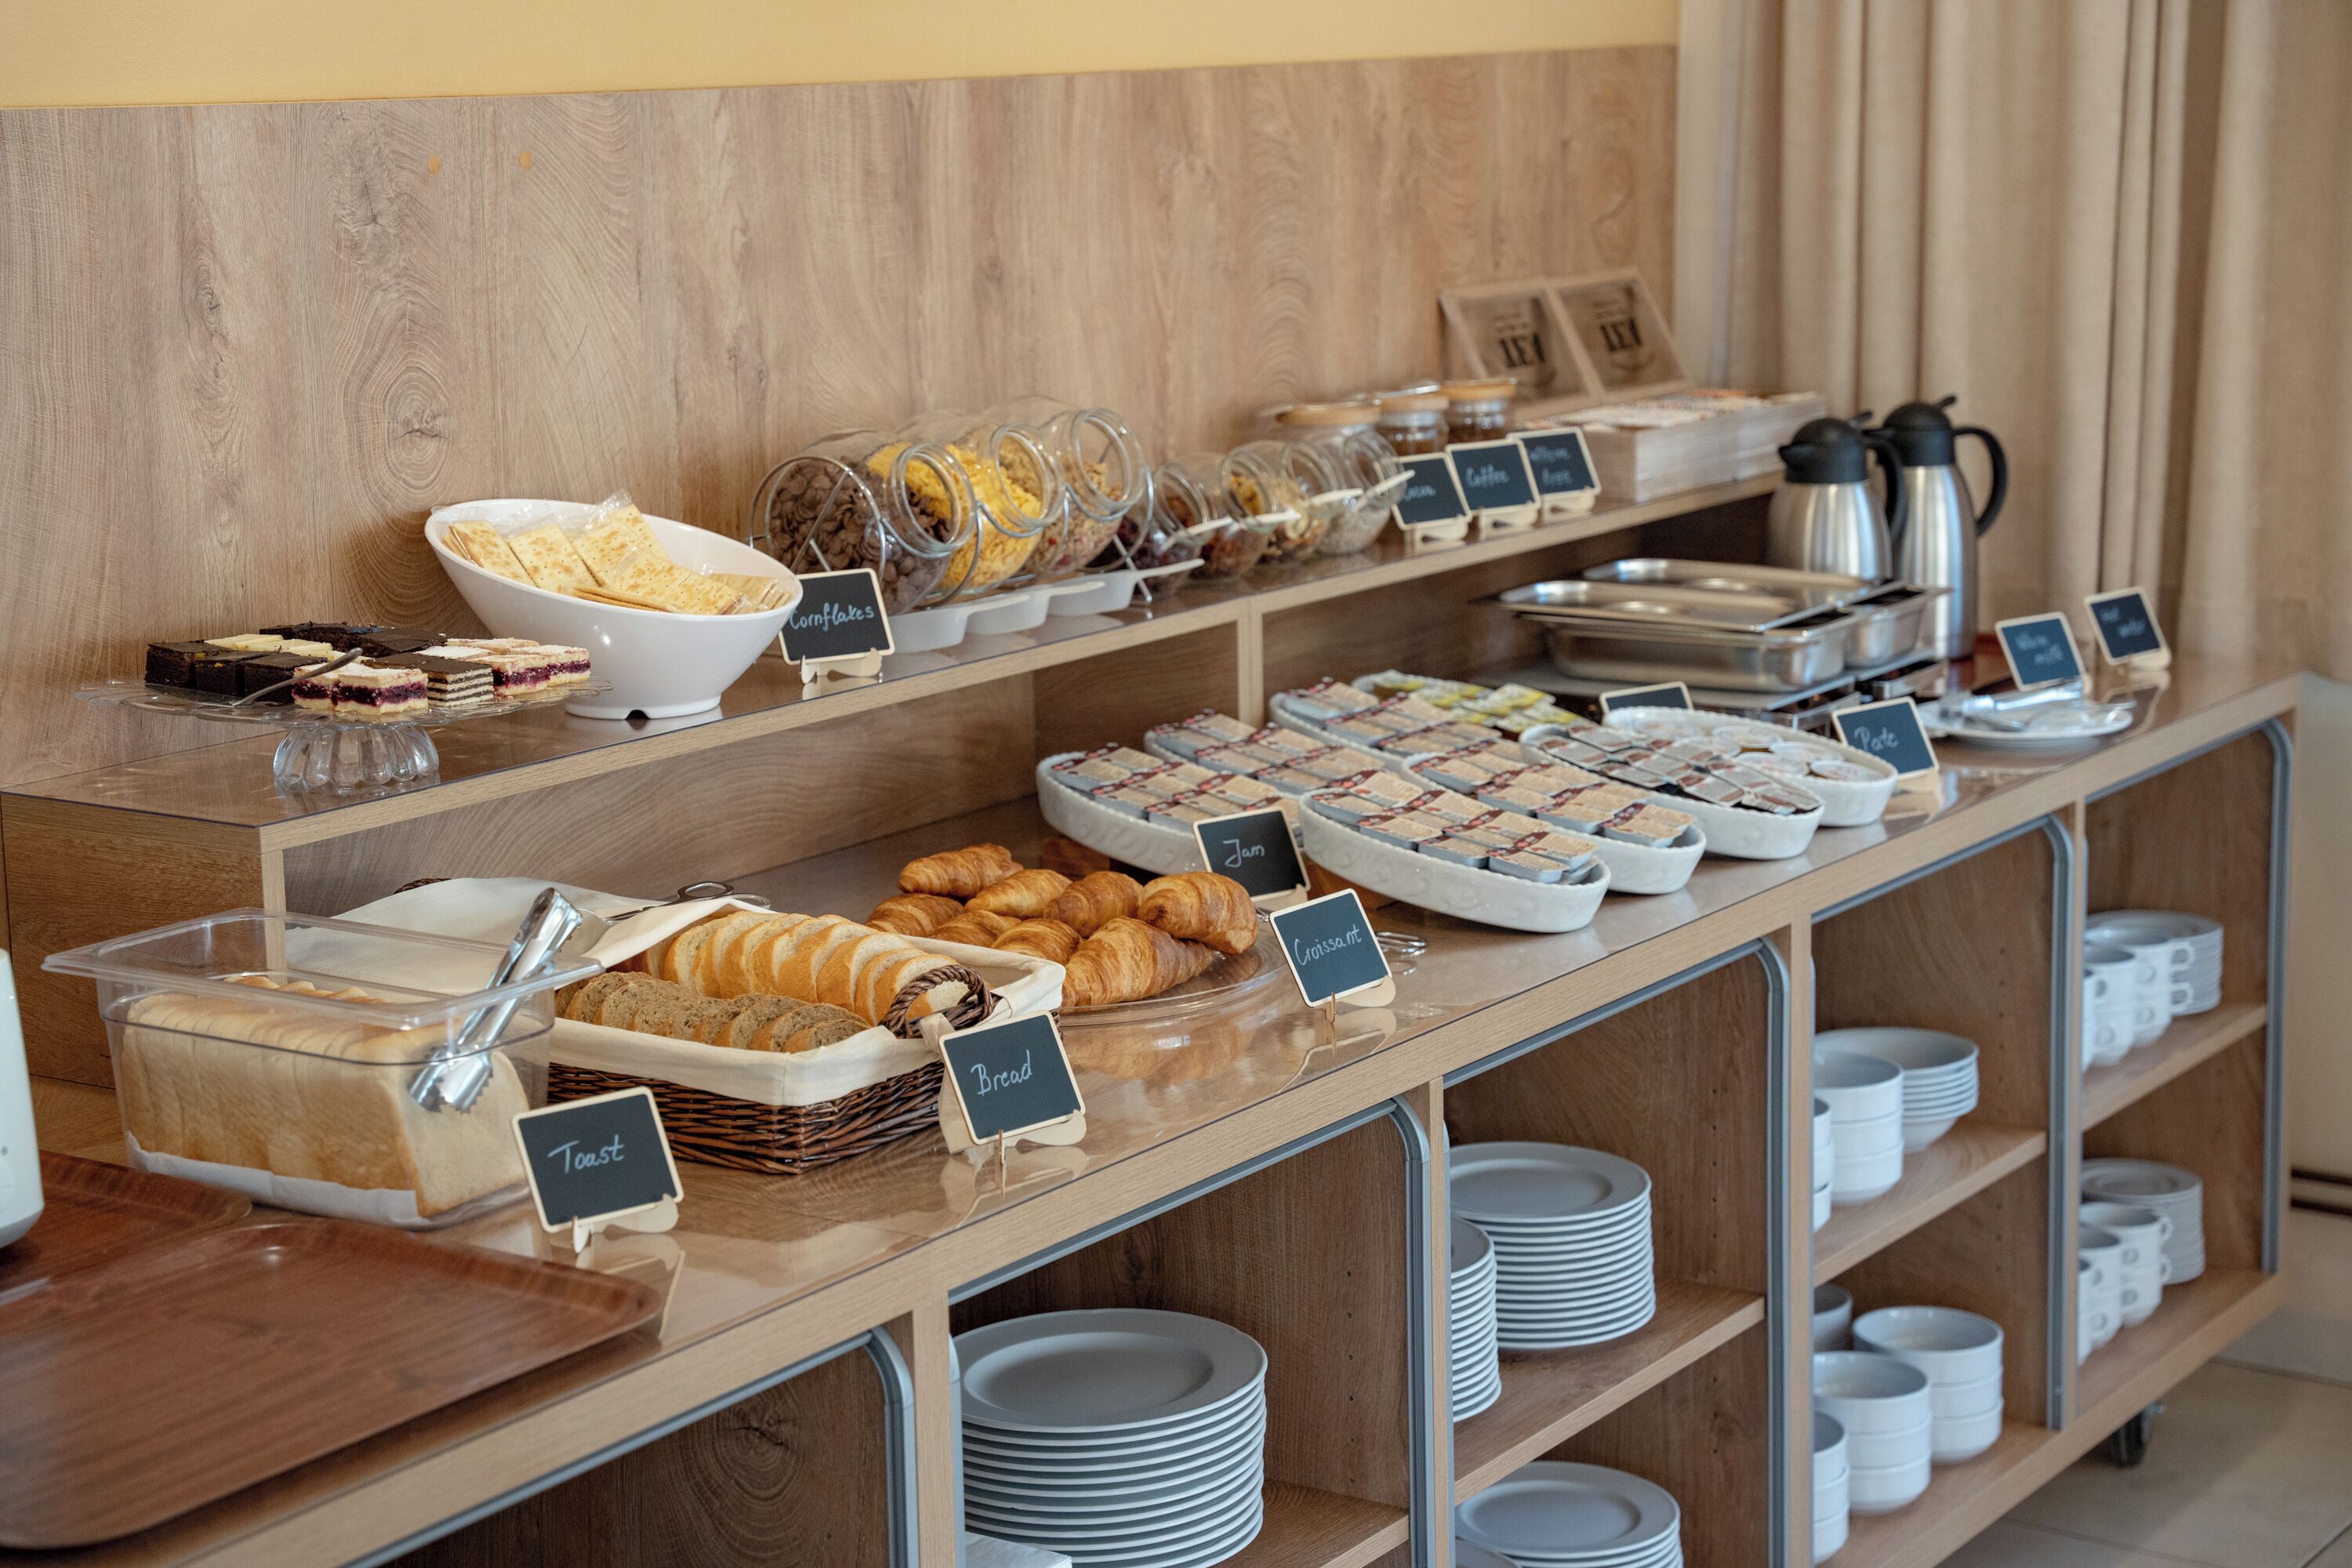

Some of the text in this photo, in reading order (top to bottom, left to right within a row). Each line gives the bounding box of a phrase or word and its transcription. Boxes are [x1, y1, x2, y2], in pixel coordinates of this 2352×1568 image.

[789, 602, 875, 631] Cornflakes
[1853, 727, 1899, 752] Pate
[1222, 838, 1265, 868] Jam
[1294, 924, 1362, 966] Croissant
[970, 1049, 1033, 1097] Bread
[547, 1134, 625, 1174] Toast
